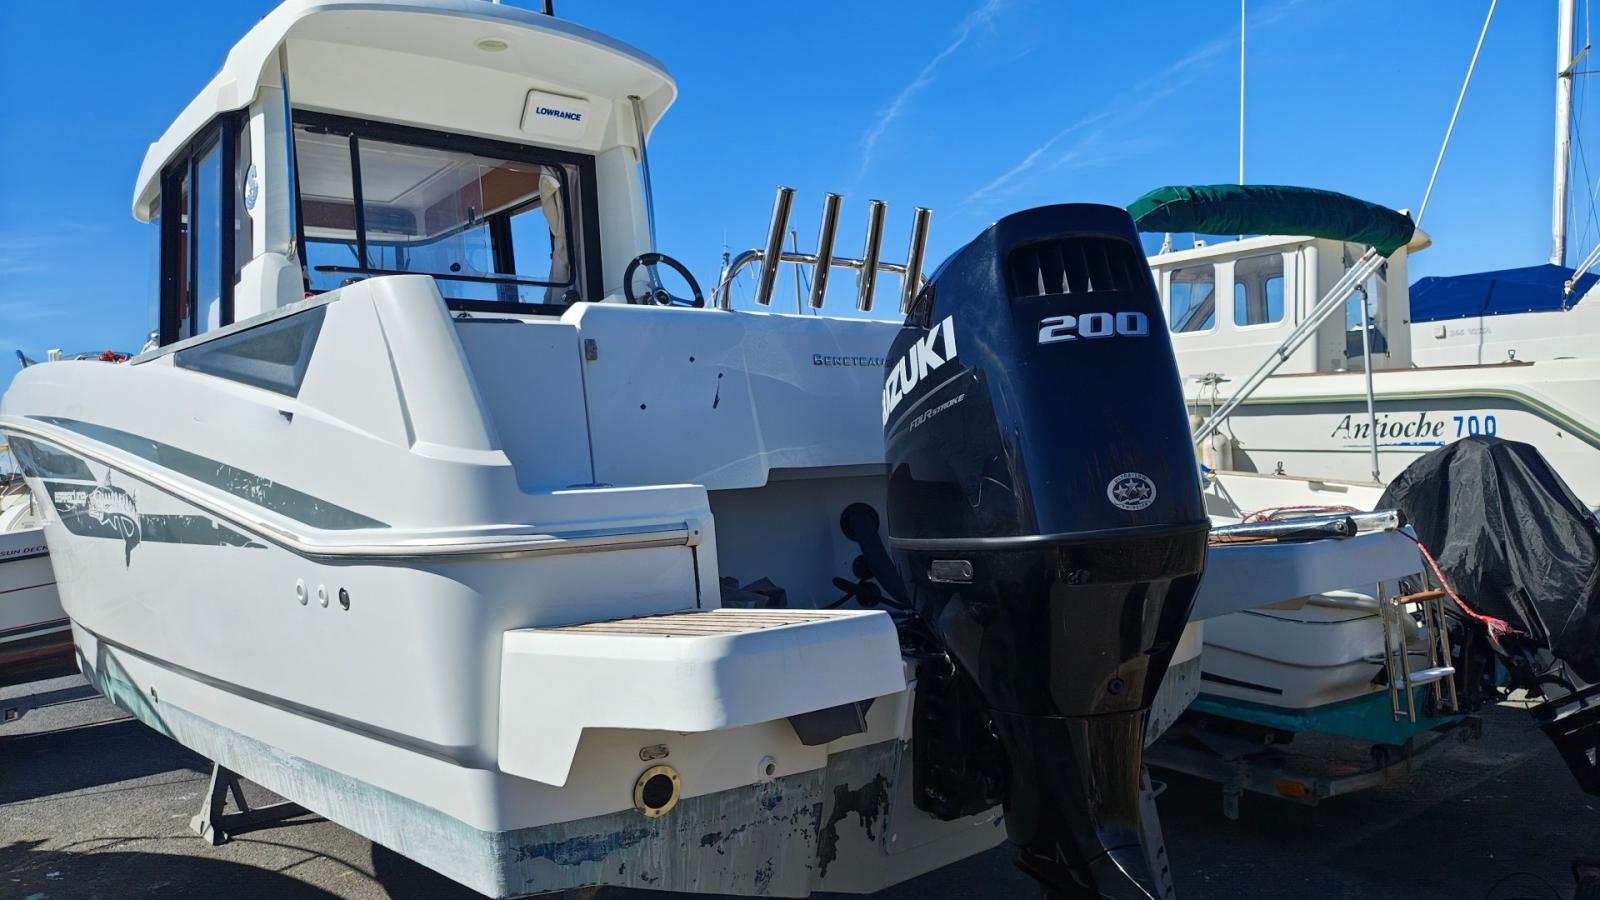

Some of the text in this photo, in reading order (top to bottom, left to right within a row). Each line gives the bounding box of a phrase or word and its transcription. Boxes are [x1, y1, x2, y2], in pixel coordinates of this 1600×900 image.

[535, 106, 582, 121] LOWRANCE
[1038, 311, 1149, 344] 200
[812, 353, 885, 367] BENETEAU
[1331, 411, 1497, 439] Antioche 700
